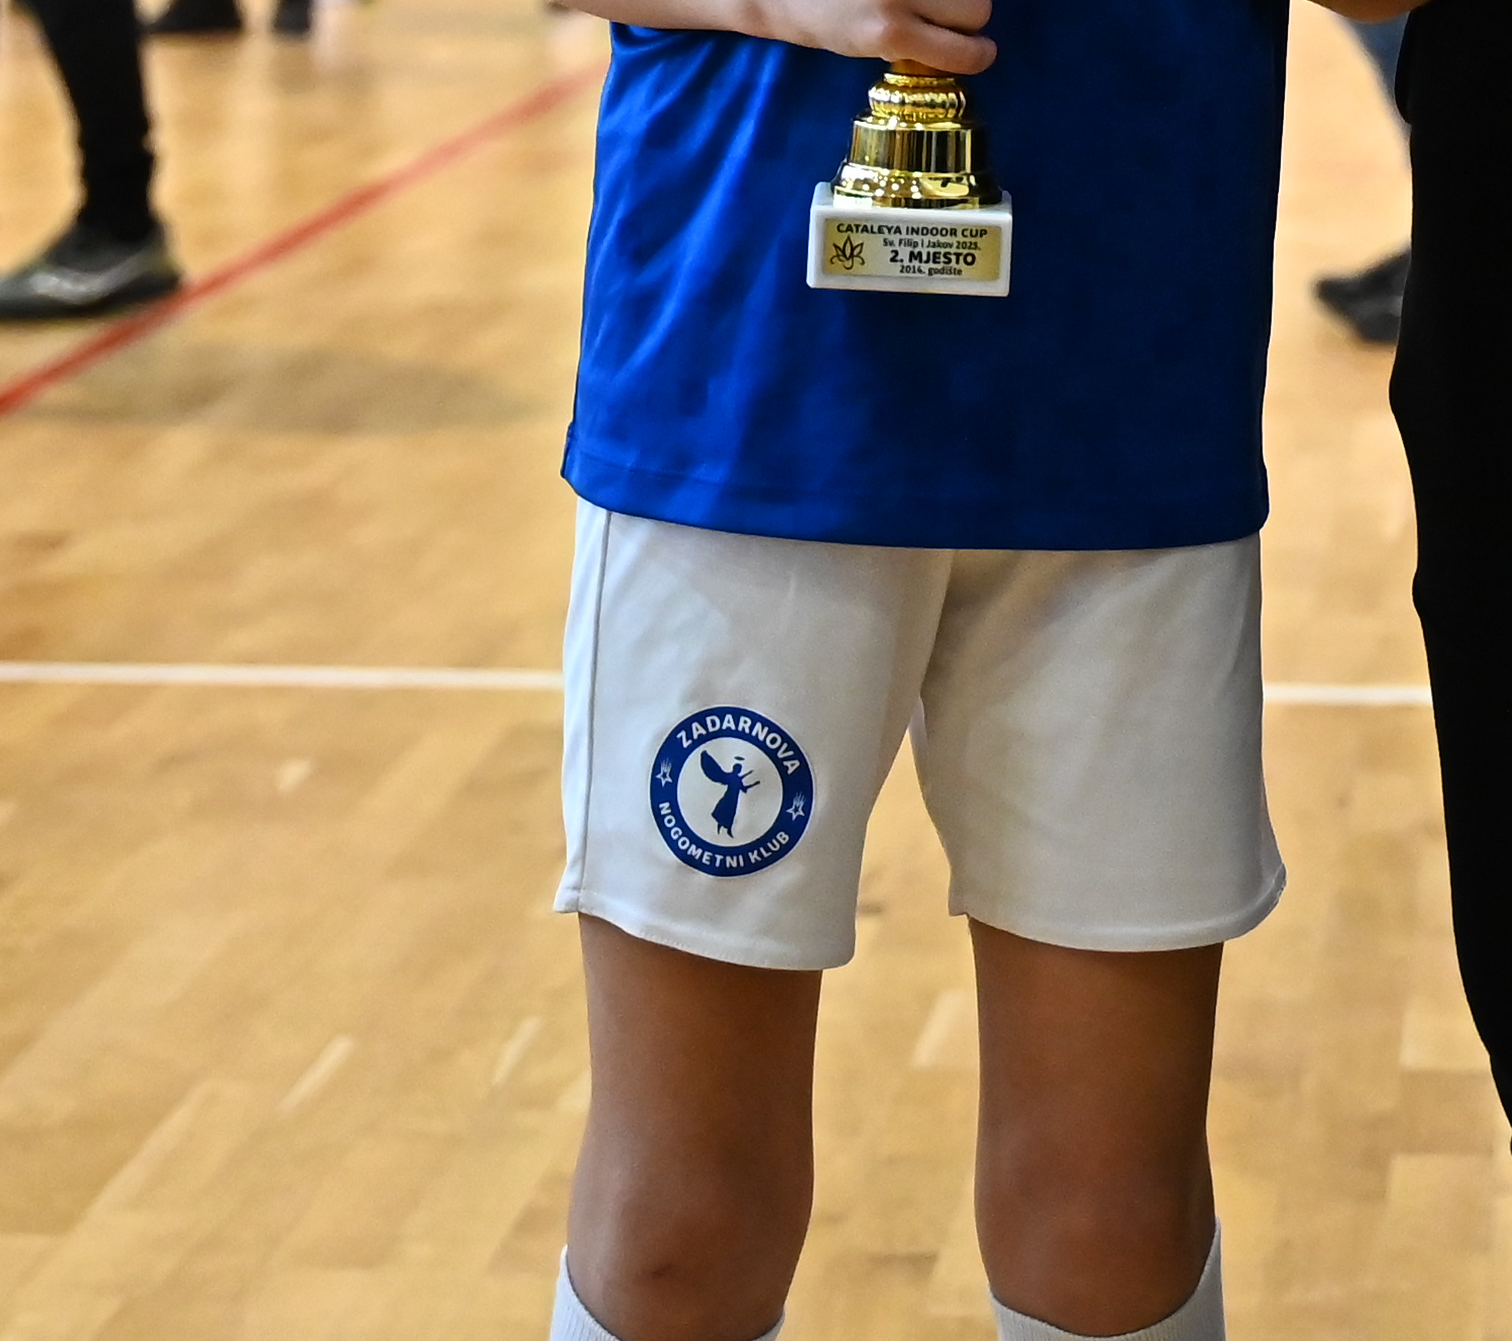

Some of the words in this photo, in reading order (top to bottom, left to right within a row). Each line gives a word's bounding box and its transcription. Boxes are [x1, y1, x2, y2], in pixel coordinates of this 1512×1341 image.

[836, 223, 903, 236] CATALEYA
[905, 226, 958, 238] INDOOR
[960, 228, 988, 239] CUP
[897, 239, 919, 250] Filip
[926, 240, 954, 250] Jakov
[889, 250, 905, 264] 2.
[908, 251, 976, 266] MJESTO
[676, 714, 801, 775] ZADARNOVA
[658, 801, 745, 869] NOGOMETNI
[748, 830, 791, 865] KLUB
